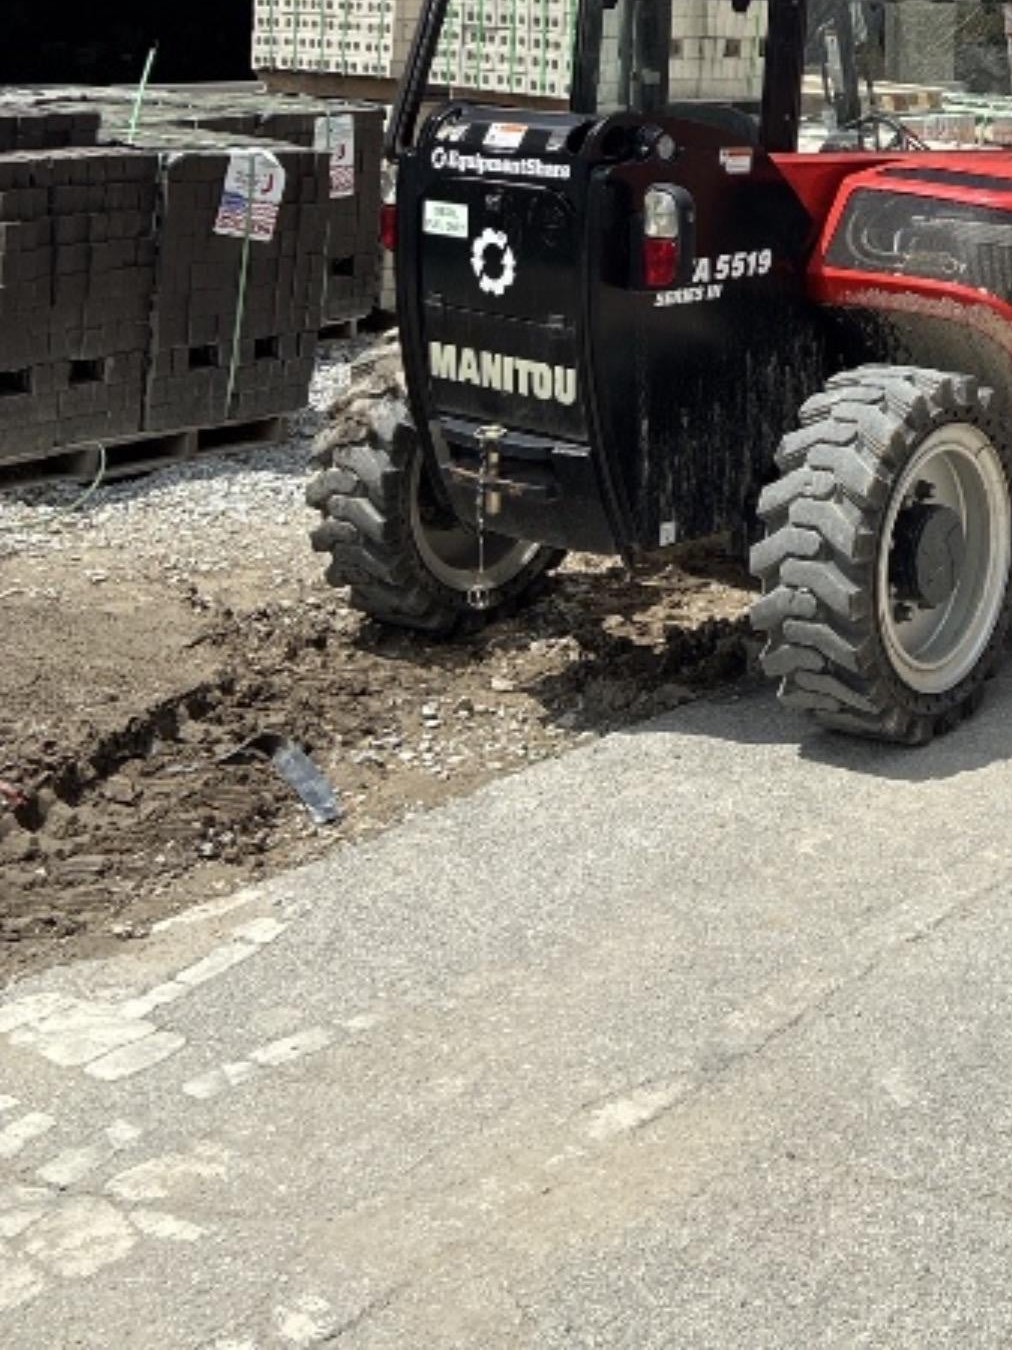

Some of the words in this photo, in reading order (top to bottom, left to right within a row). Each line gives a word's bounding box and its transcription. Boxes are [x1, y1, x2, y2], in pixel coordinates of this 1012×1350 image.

[447, 149, 571, 178] EquipmentShare
[715, 248, 772, 281] 5519
[429, 341, 577, 406] MANITOU
